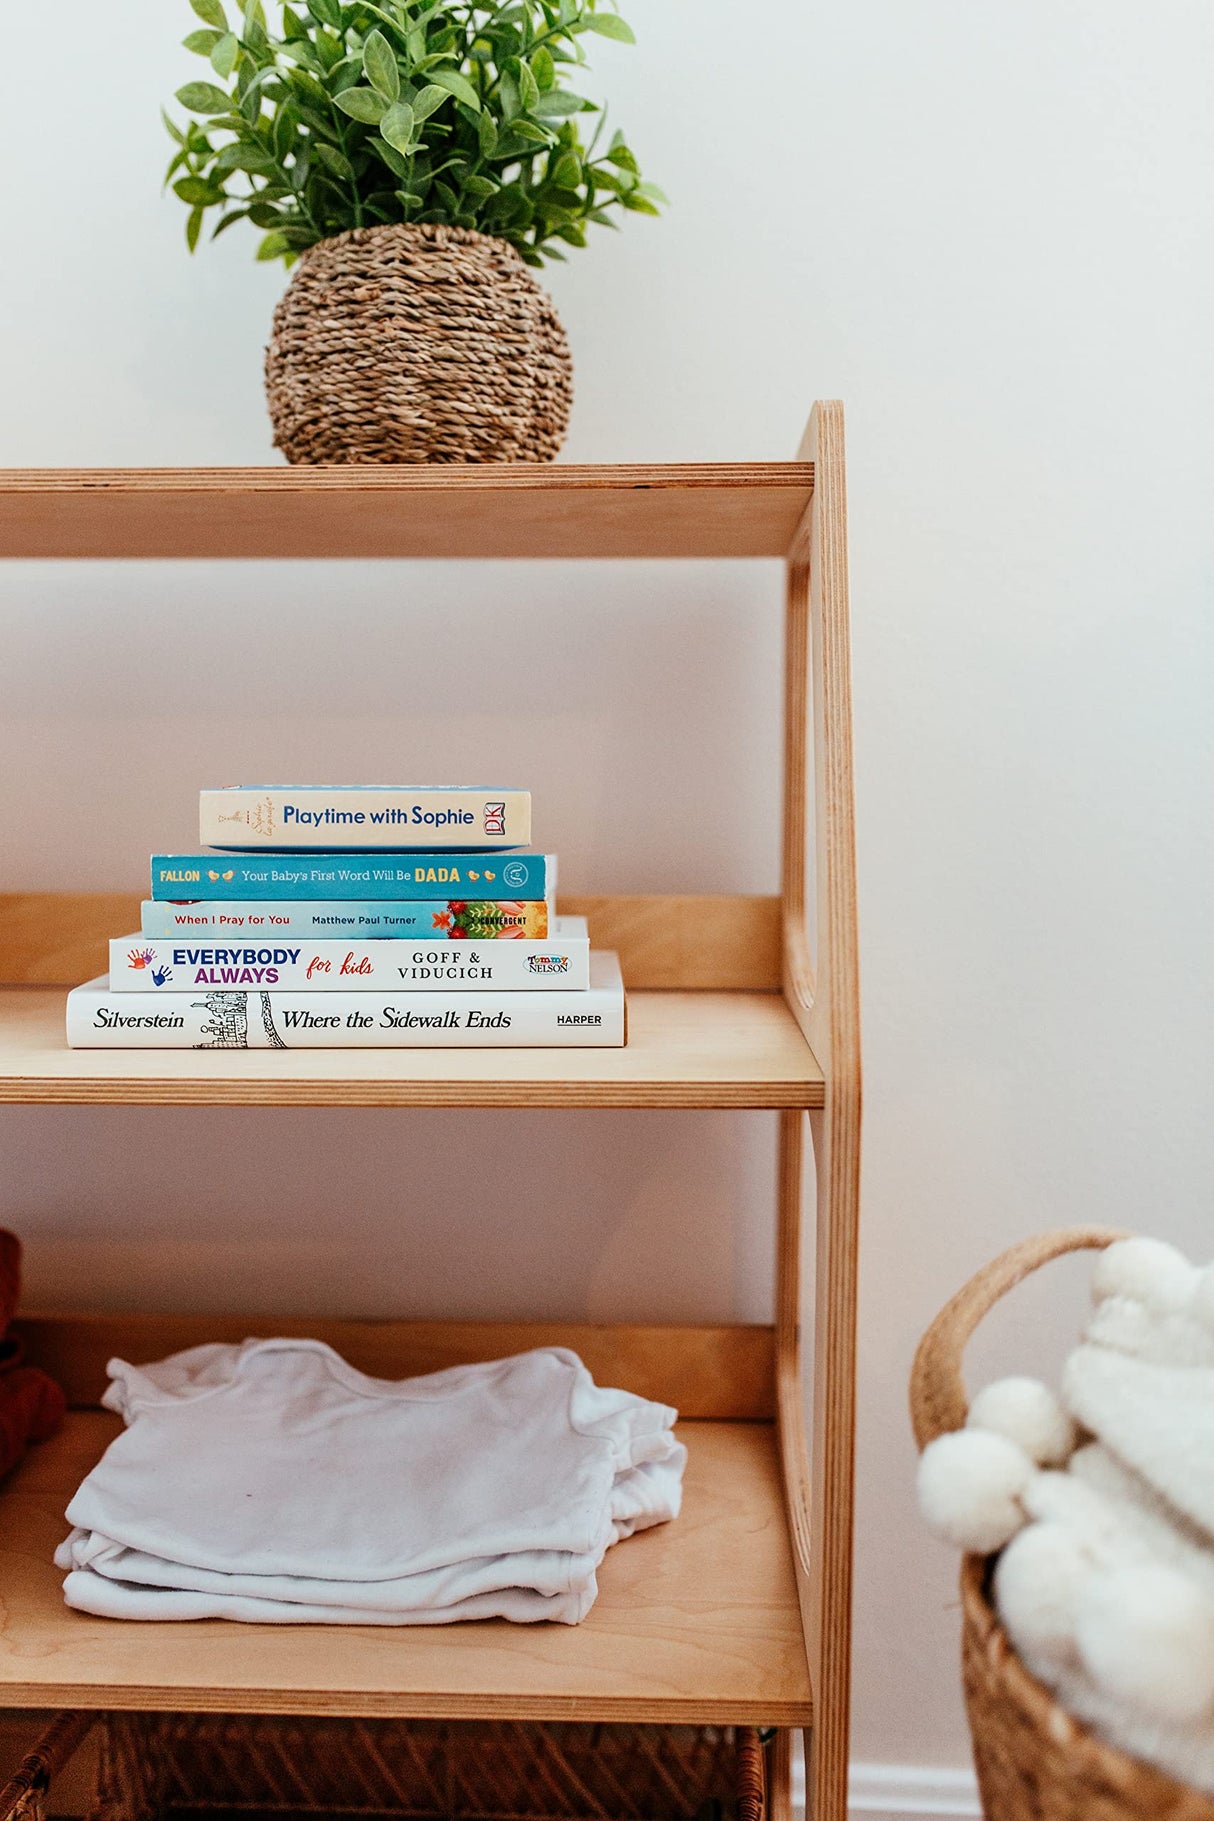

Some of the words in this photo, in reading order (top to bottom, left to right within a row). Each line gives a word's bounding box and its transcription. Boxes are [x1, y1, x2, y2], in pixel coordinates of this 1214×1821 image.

[283, 805, 366, 827] Playtime
[370, 808, 408, 824] with
[411, 805, 475, 828] Sophie
[485, 806, 502, 832] DK
[160, 870, 200, 882] FALLON
[242, 870, 268, 881] Your
[271, 870, 308, 883] Baby's
[311, 870, 335, 881] First
[338, 870, 370, 881] Word
[372, 870, 394, 881] Will
[396, 871, 411, 881] Be
[415, 867, 461, 882] DADA
[175, 915, 208, 924] When
[212, 915, 215, 924] I
[219, 915, 245, 926] Pray
[248, 915, 265, 924] for
[268, 915, 290, 924] You
[312, 916, 354, 924] Matthew
[358, 916, 380, 924] Paul
[383, 916, 416, 924] Turner
[480, 916, 527, 925] CONVERGENT
[173, 948, 302, 965] EVERYBODY
[412, 952, 462, 964] GOFF
[469, 952, 481, 964] &
[527, 955, 568, 965] Tommy
[306, 956, 332, 980] for
[339, 951, 375, 975] kids
[529, 964, 568, 973] NELSON
[194, 967, 279, 984] ALWAYS
[398, 967, 493, 979] VIDUCICH
[93, 1007, 185, 1028] Silverstein
[282, 1010, 341, 1028] Where
[346, 1010, 374, 1028] the
[379, 1006, 460, 1028] Sidewalk
[465, 1011, 512, 1028] Ends
[557, 1015, 602, 1024] HARPER
